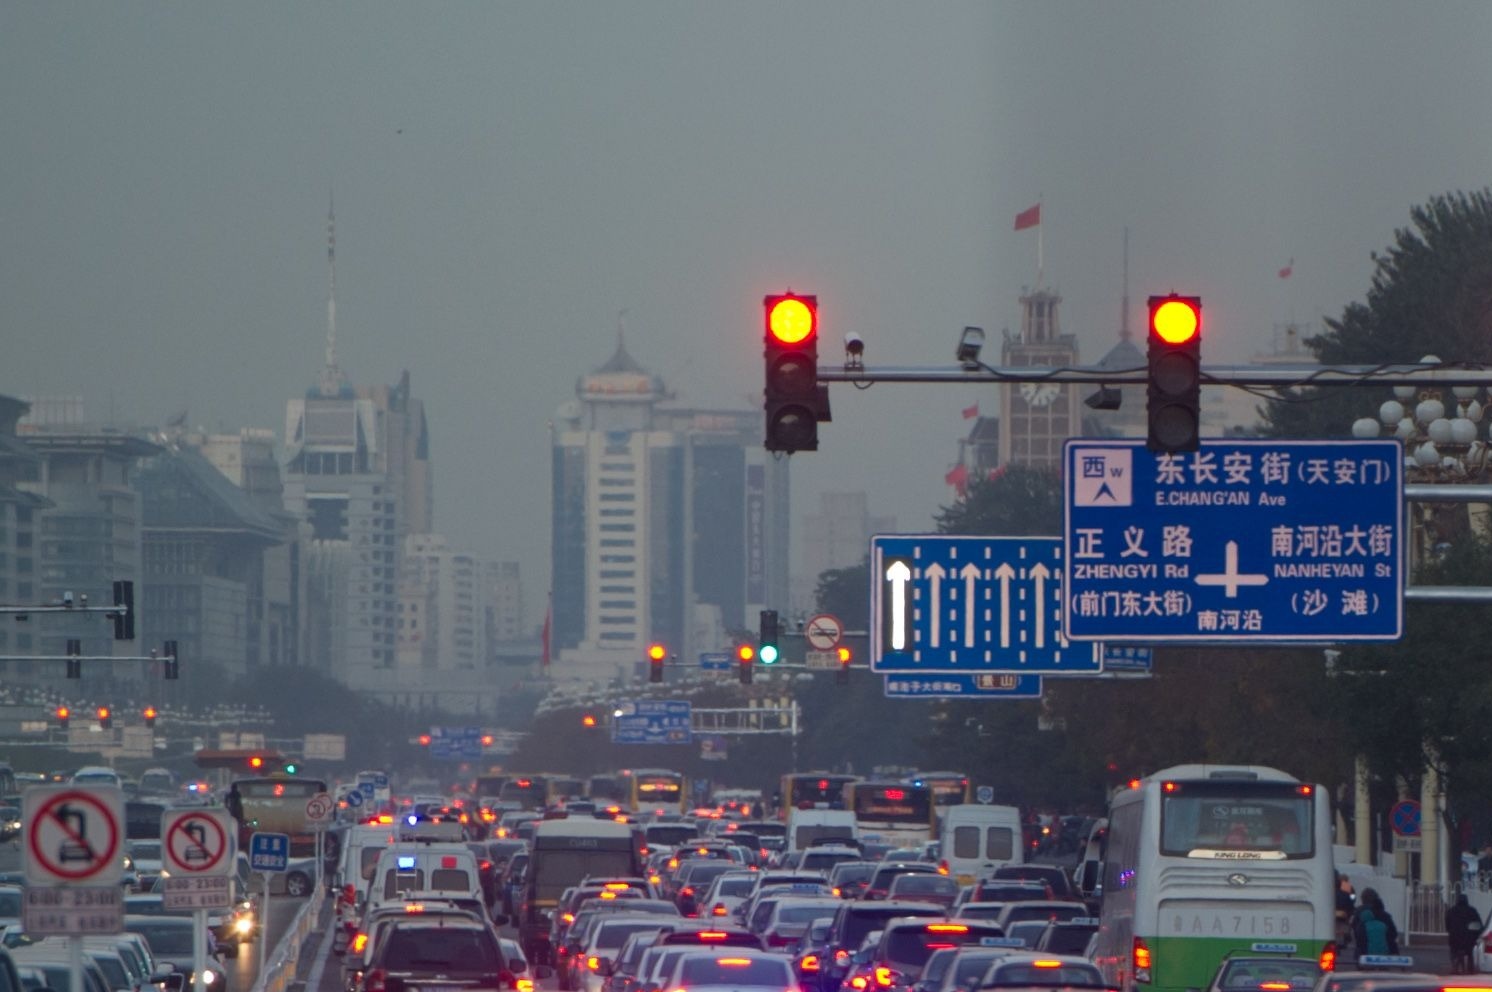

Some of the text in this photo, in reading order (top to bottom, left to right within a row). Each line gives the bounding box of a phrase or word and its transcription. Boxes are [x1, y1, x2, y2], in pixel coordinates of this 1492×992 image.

[1082, 456, 1106, 478] 西
[1110, 467, 1123, 478] W
[1155, 490, 1287, 507] E.CHANG'AN Ave
[1074, 525, 1193, 559] 正义路
[1271, 524, 1393, 558] 南河沿大街
[1073, 564, 1189, 579] ZHENGYI Rd
[1274, 563, 1392, 578] NANHEYAN St
[1072, 590, 1193, 617] (前门东大街)
[1291, 589, 1379, 616] (沙滩)
[1197, 610, 1263, 631] 南河沿
